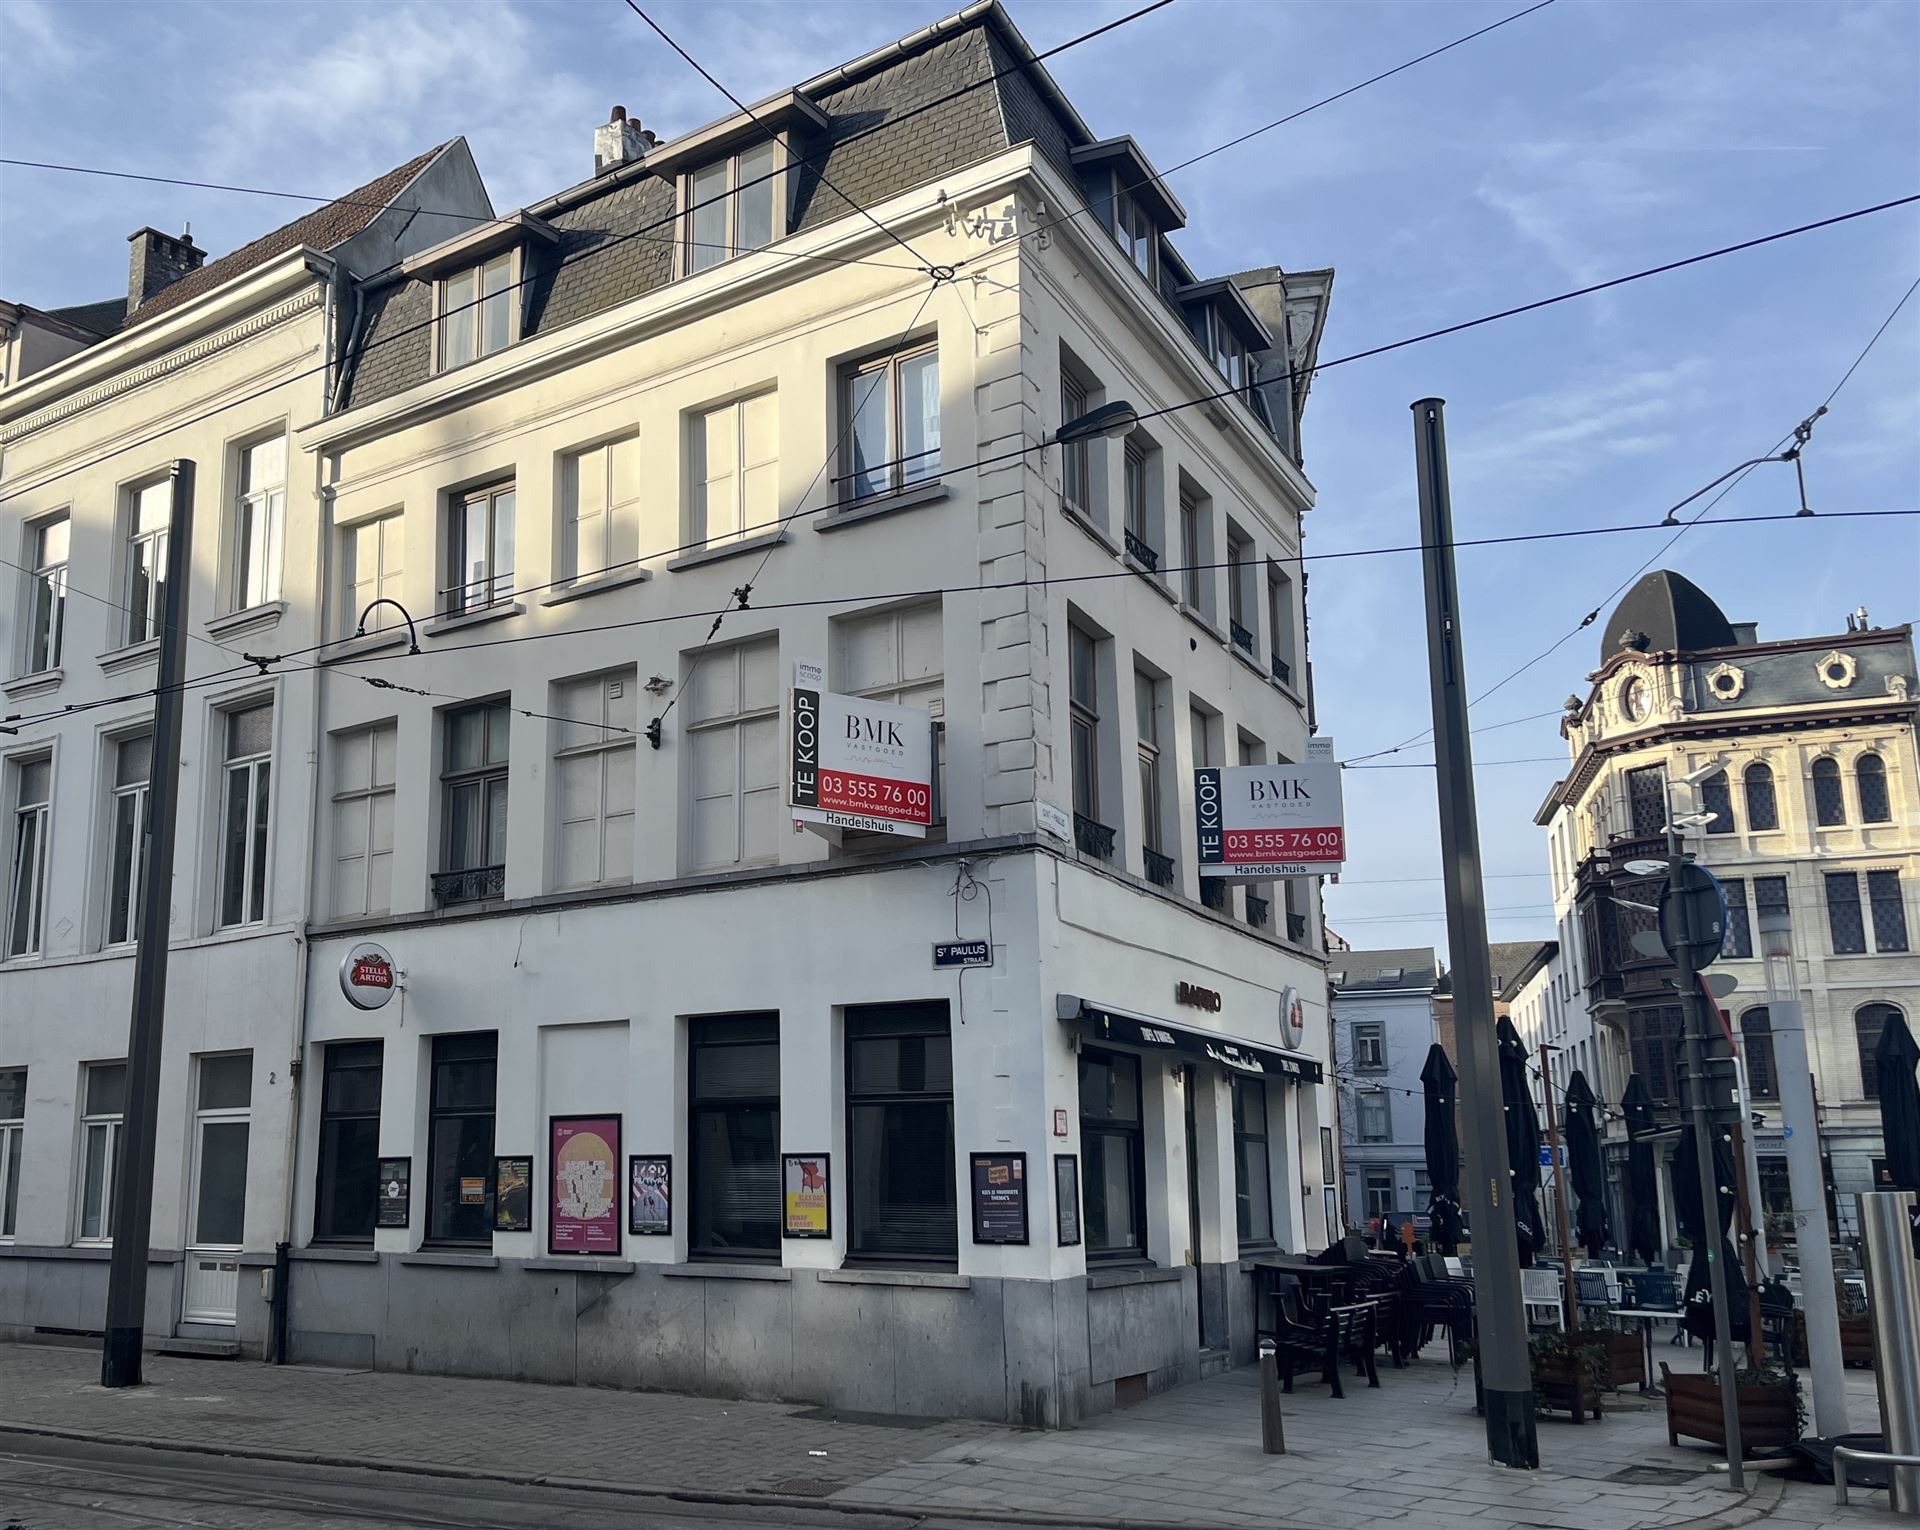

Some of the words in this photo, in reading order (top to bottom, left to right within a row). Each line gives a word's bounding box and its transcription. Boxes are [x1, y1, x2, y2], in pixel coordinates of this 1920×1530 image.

[799, 664, 822, 674] immo
[797, 697, 815, 764] KOOP
[845, 714, 905, 747] BMK
[846, 742, 904, 756] VASTGOED
[797, 771, 814, 798] TE
[822, 776, 843, 794] 03
[848, 781, 877, 799] 555
[883, 785, 902, 802] 76
[907, 789, 927, 806] 00
[1249, 778, 1312, 801] BMK
[822, 795, 927, 817] www.bmkvastgoed.be
[1199, 774, 1218, 829] KOOP
[1251, 801, 1311, 809] VASTGOED
[826, 812, 894, 833] Handelshuis
[1202, 835, 1219, 858] TE
[1227, 835, 1249, 849] 03
[1254, 834, 1285, 848] 555
[1291, 833, 1311, 847] 76
[1317, 832, 1338, 846] 00
[1228, 849, 1339, 858] www.bmkvastgoed.be
[1234, 864, 1307, 875] Handelshuis
[951, 945, 985, 956] PAULUS
[360, 966, 387, 976] STELLA
[360, 974, 388, 983] ARTOIS
[270, 1071, 276, 1085] 2
